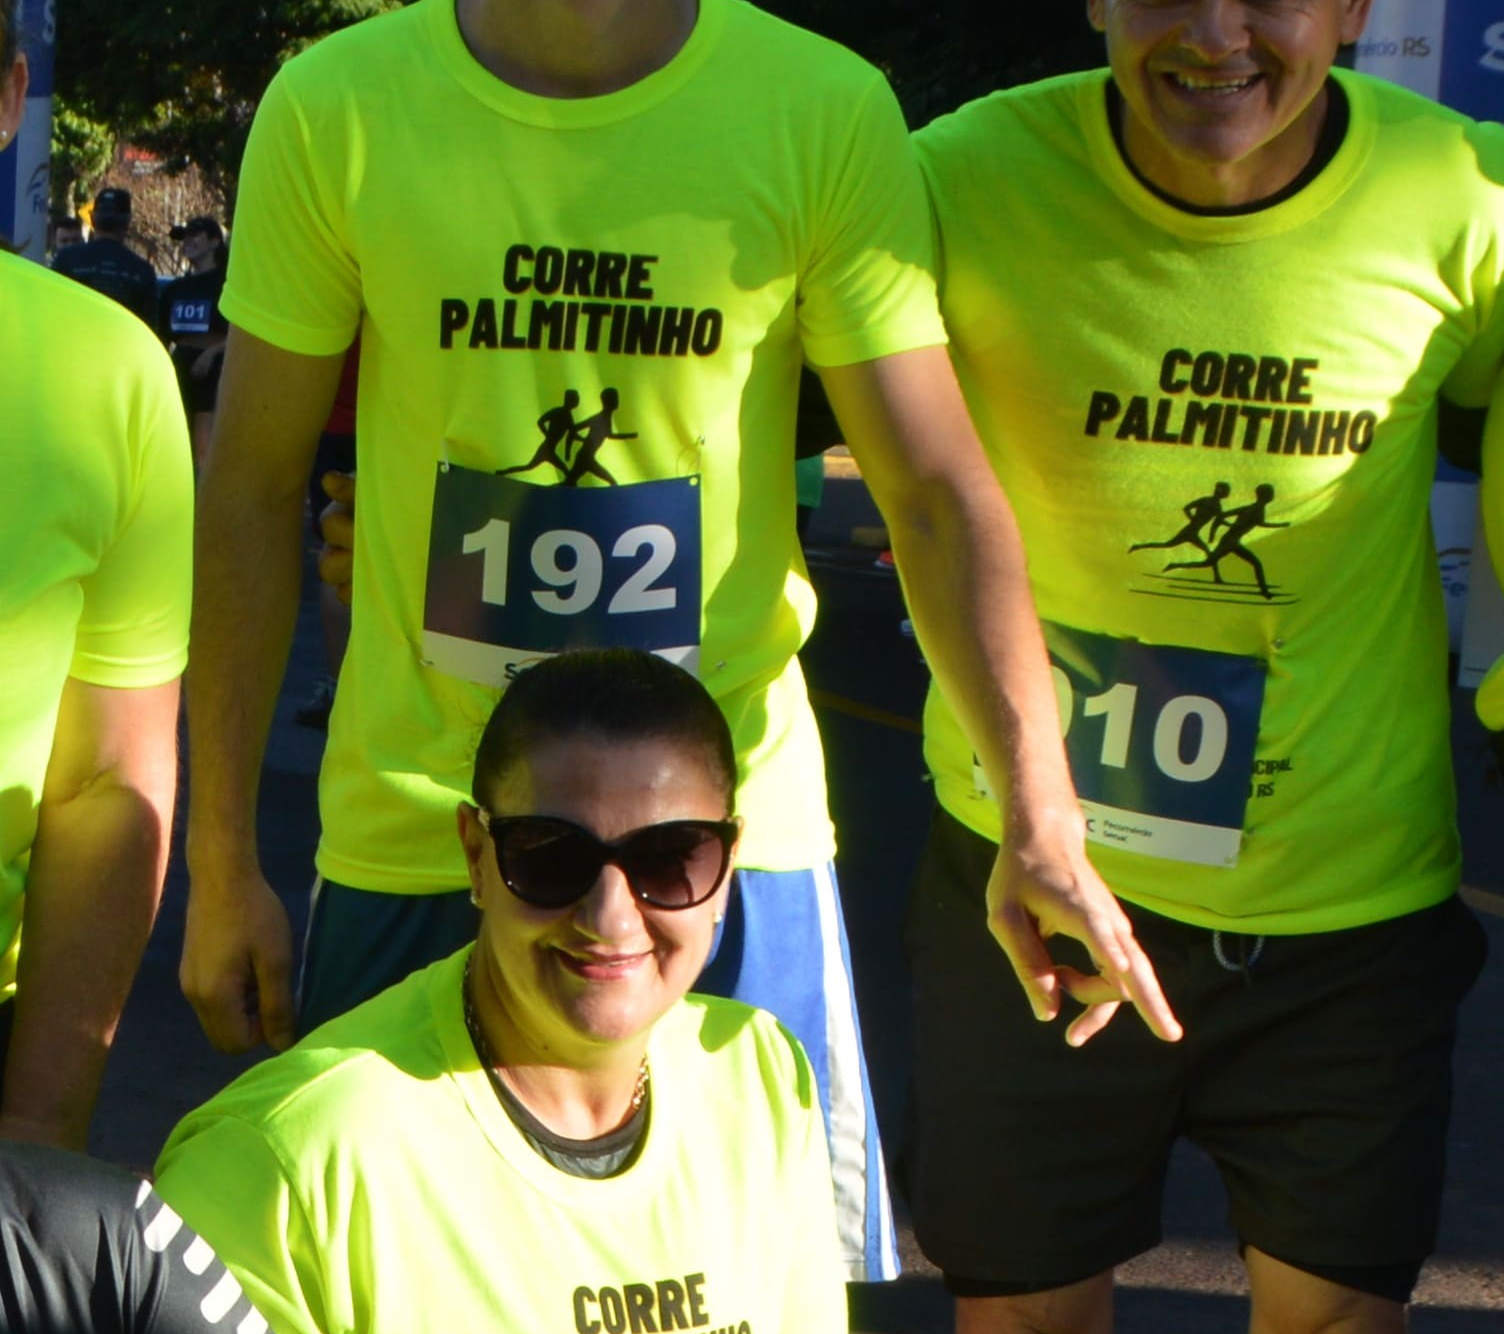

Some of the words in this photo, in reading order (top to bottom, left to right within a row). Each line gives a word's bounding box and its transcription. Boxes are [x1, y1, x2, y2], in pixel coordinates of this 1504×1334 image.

[1402, 37, 1431, 57] RS
[503, 243, 659, 300] CORRE
[175, 304, 205, 319] 101
[440, 298, 723, 357] PALMITINHO
[1159, 348, 1319, 405] CORRE
[1084, 390, 1378, 457] PALMITINHO
[462, 518, 677, 615] 192
